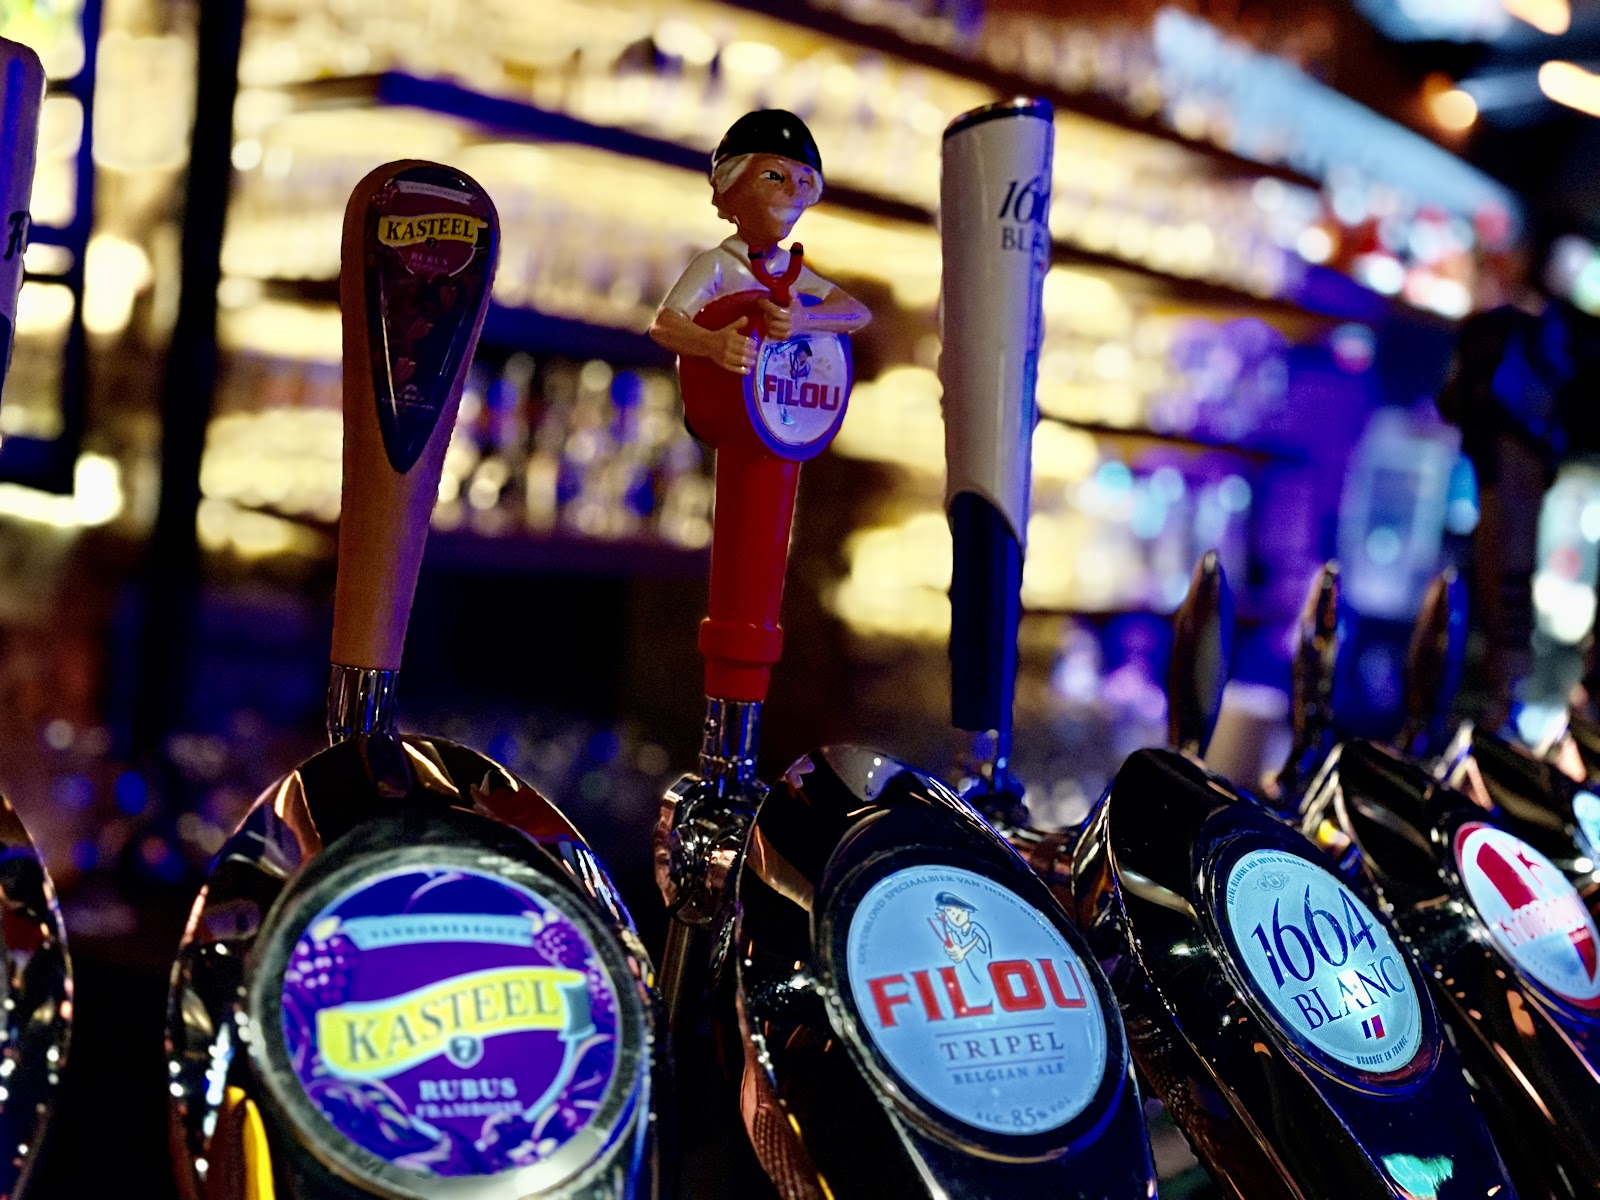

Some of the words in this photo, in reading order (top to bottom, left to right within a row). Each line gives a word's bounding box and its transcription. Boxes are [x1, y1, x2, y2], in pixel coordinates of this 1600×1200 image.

[386, 218, 474, 241] KASTEEL
[762, 374, 841, 411] FILOU
[957, 877, 980, 888] VAN
[1250, 884, 1377, 990] 1664
[867, 958, 1087, 1029] FILOU
[1290, 955, 1406, 1031] BLANC
[344, 979, 561, 1065] KASTEEL
[940, 1031, 1065, 1062] TRIPEL
[418, 1076, 518, 1102] RUBUS
[952, 1065, 1029, 1086] BELGIAN
[1036, 1061, 1065, 1076] ALE
